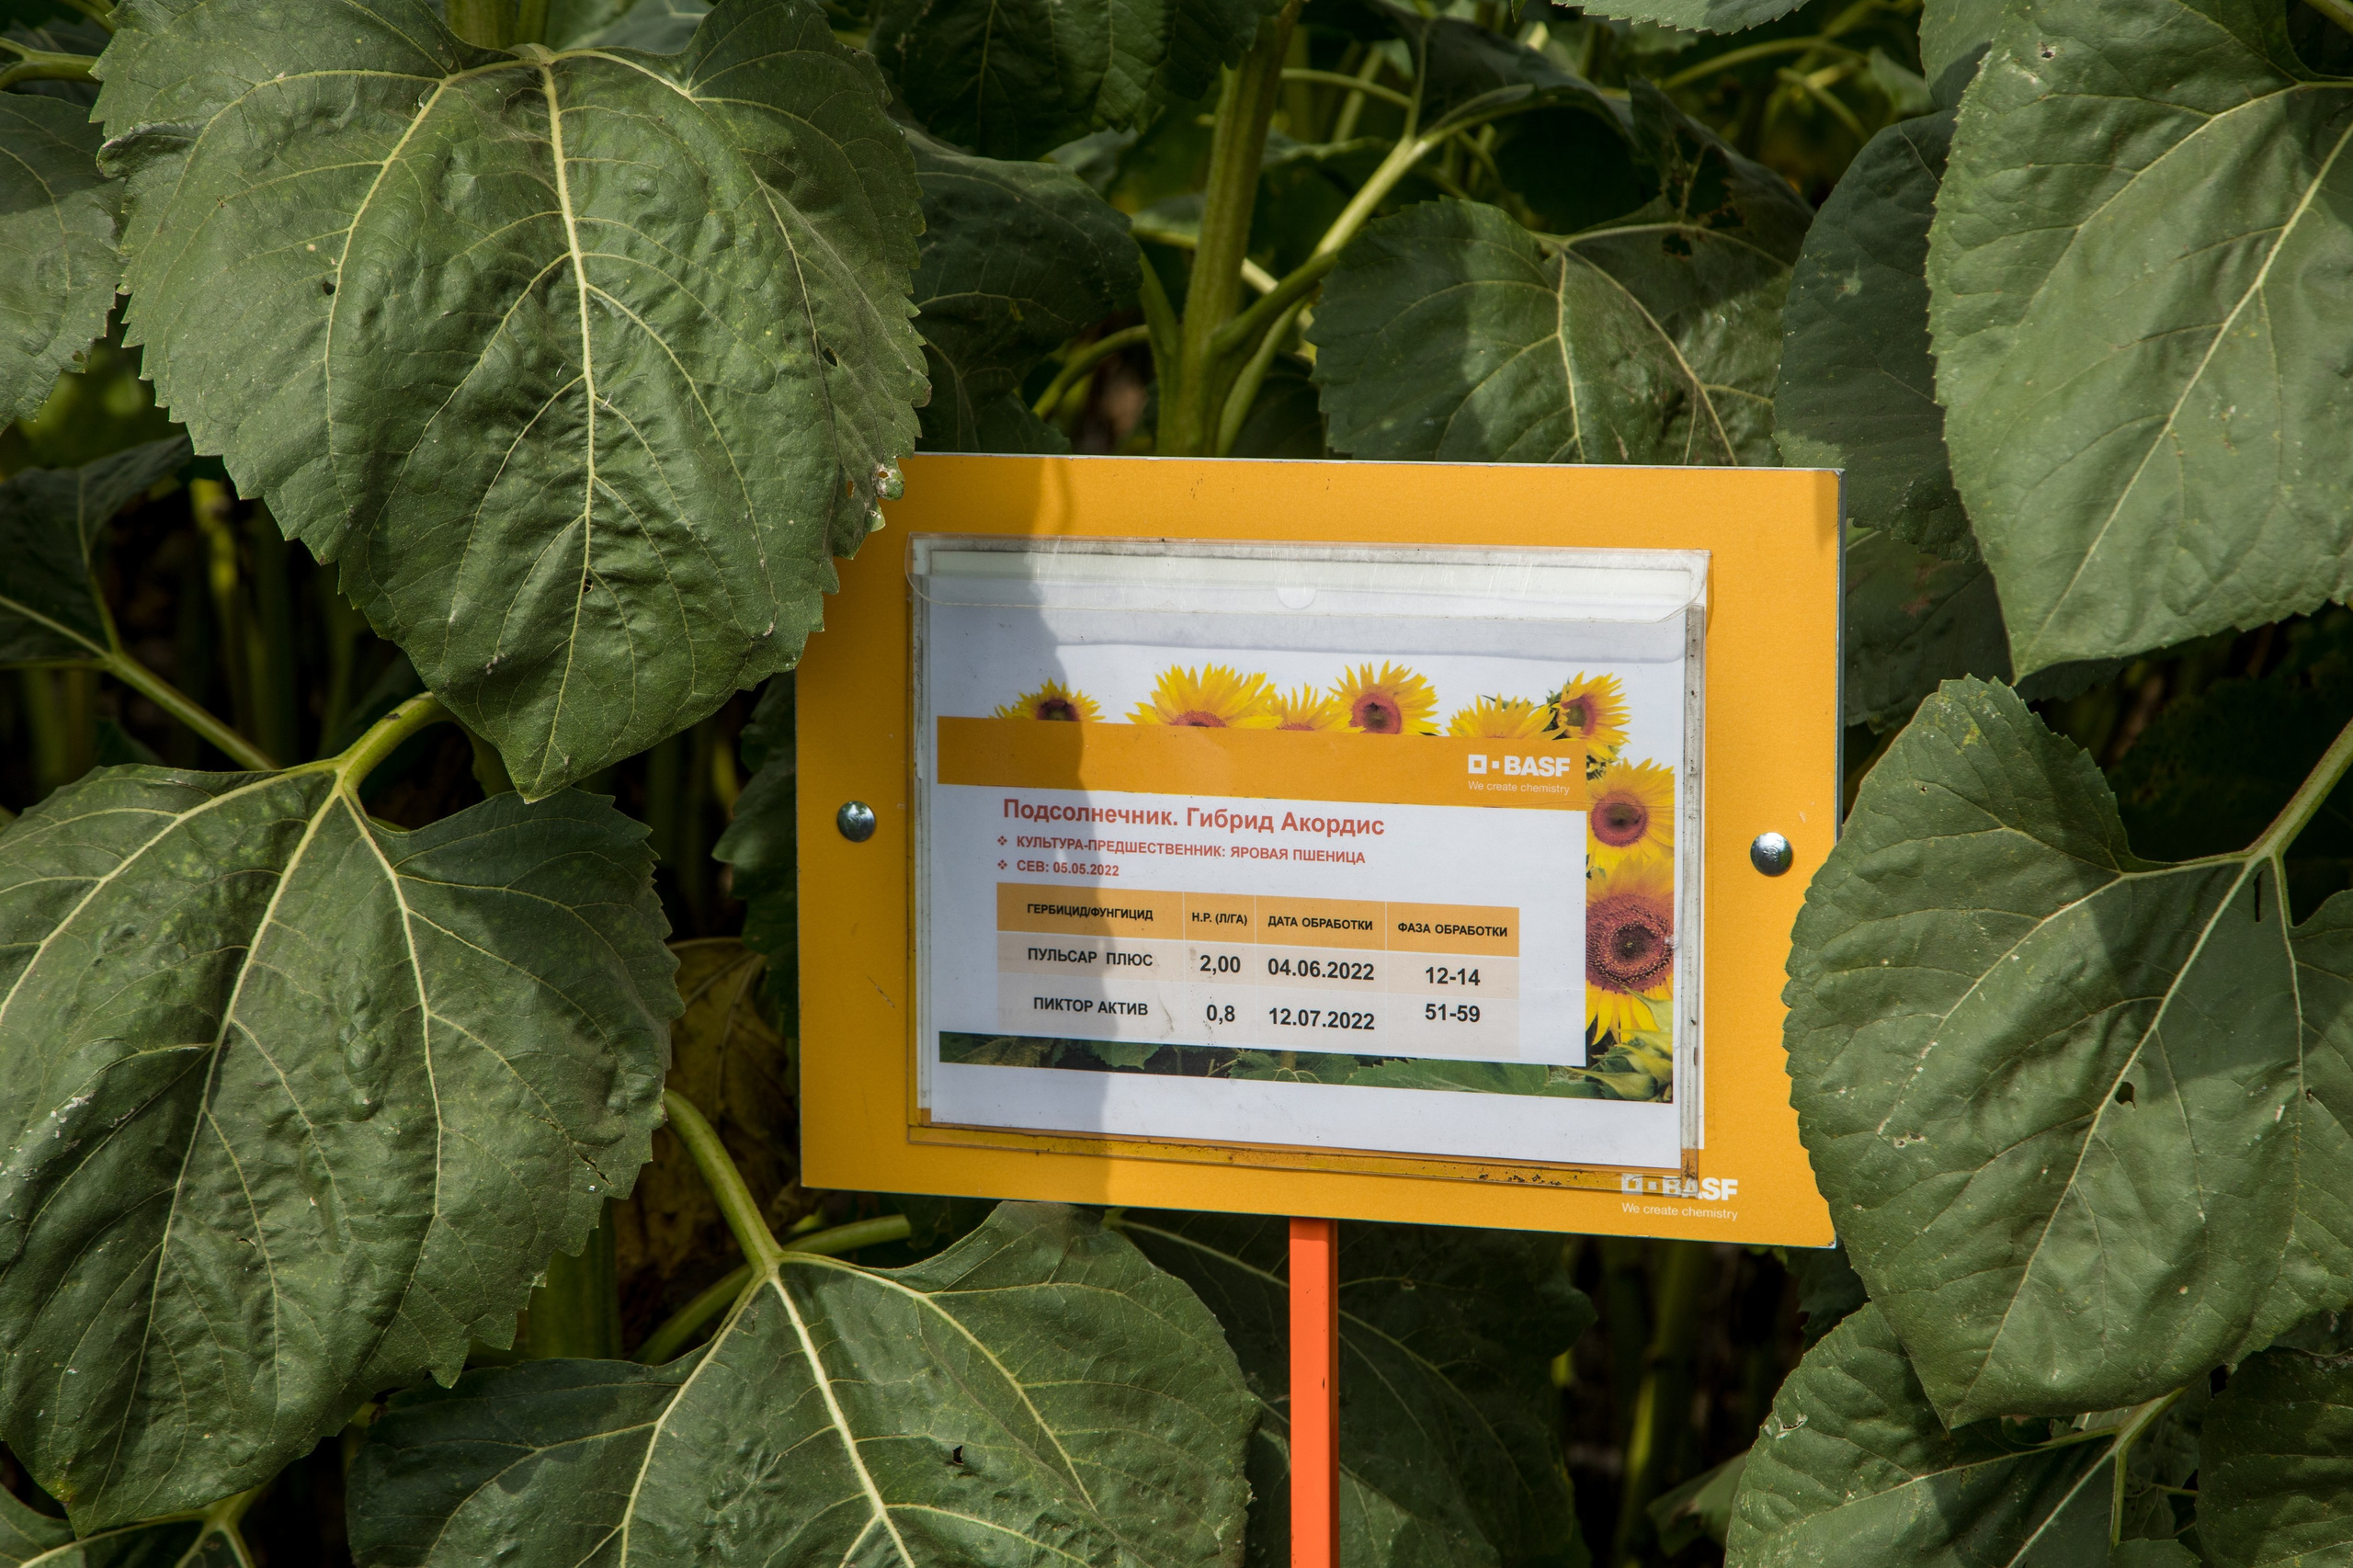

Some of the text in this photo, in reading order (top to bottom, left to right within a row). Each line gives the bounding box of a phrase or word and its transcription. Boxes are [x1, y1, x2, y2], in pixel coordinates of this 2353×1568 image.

[1504, 756, 1570, 778] BASF
[1468, 780, 1570, 795] We create chemistry
[1003, 799, 1384, 837] Подсолнечник. Гибрид Акордис
[1017, 835, 1366, 864] КУЛЬТУРА-ПРЕДШЕСТВЕННИК: ЯРОВАЯ ПШЕНИЦА
[1017, 859, 1120, 877] СЕВ: 05.05.2022
[1027, 903, 1153, 922] ГЕРБИЦИД/ФУНГИЦИД
[1191, 912, 1248, 926] Н.Р. (Л/ГА)
[1267, 915, 1373, 931] ДАТА ОБРАБОТКИ
[1398, 922, 1507, 937] ФАЗА ОБРАБОТКИ
[1028, 948, 1154, 967] ПУЛЬСАР ПЛЮС
[1199, 955, 1241, 976] 2,00
[1267, 958, 1374, 981] 04.06.2022
[1426, 967, 1481, 986] 12-14
[1033, 997, 1149, 1016] ПИКТОР АКТИВ
[1206, 1004, 1235, 1026] 0,8
[1425, 1003, 1481, 1023] 51-59
[1268, 1007, 1375, 1030] 12.07.2022
[1663, 1176, 1738, 1200] BASF
[1621, 1202, 1738, 1221] We create chemistry
